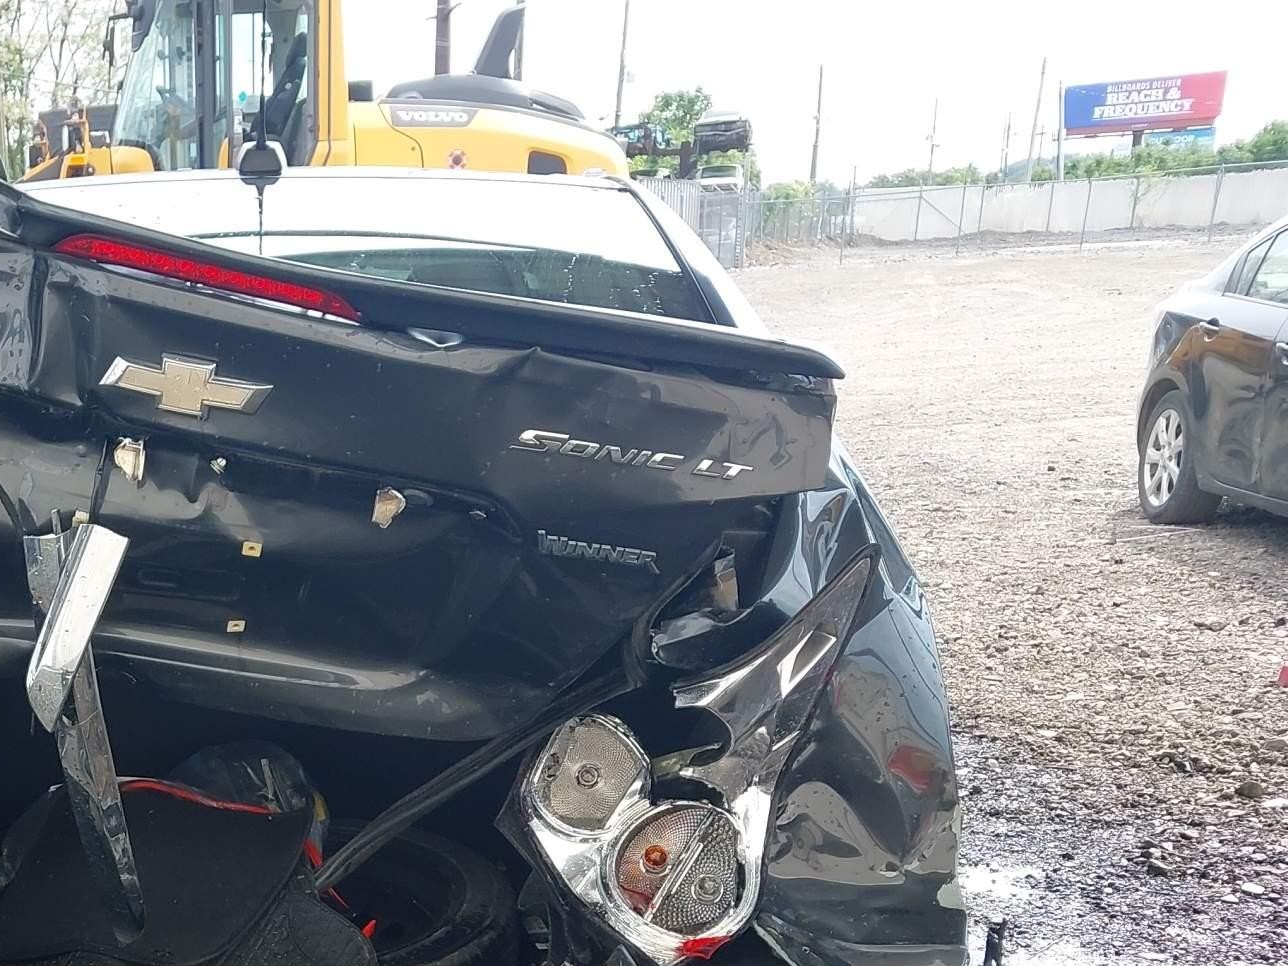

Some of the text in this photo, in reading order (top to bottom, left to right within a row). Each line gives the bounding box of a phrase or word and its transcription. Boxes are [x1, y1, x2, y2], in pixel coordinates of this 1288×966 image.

[1107, 79, 1182, 92] BILLBOARDS DELIVER
[1105, 87, 1181, 105] REACH &
[396, 110, 469, 122] VOLVO
[1092, 98, 1194, 119] FREQUENCY
[509, 429, 754, 480] SONIC LT
[537, 529, 661, 574] WINNER
